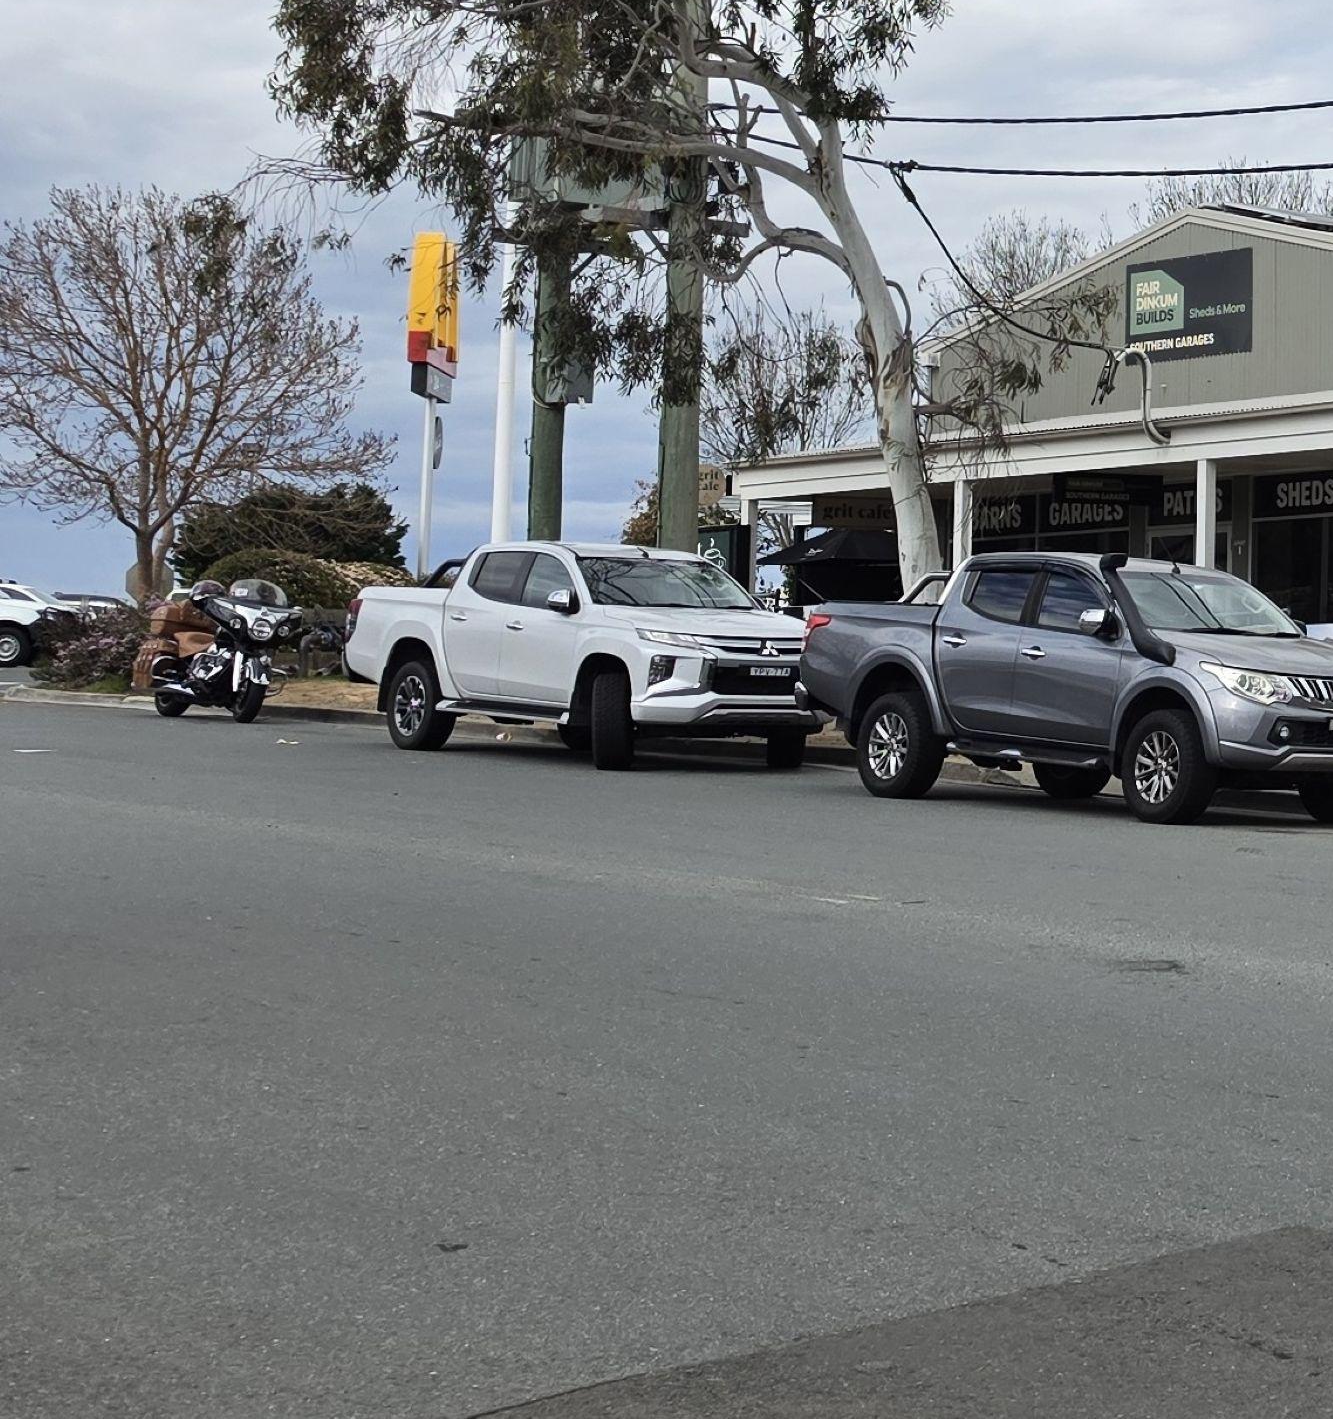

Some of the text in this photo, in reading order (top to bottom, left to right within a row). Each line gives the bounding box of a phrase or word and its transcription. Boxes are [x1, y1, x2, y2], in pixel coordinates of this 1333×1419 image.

[1136, 281, 1160, 296] FAIR
[1136, 293, 1178, 311] DINKUM
[1136, 309, 1174, 325] BUILDS
[1189, 303, 1246, 319] Sheds & More
[1130, 333, 1214, 352] SOUTHERN GARAGES
[823, 503, 853, 520] grit
[1049, 501, 1124, 526] GARAGES
[1163, 488, 1223, 516] PATS
